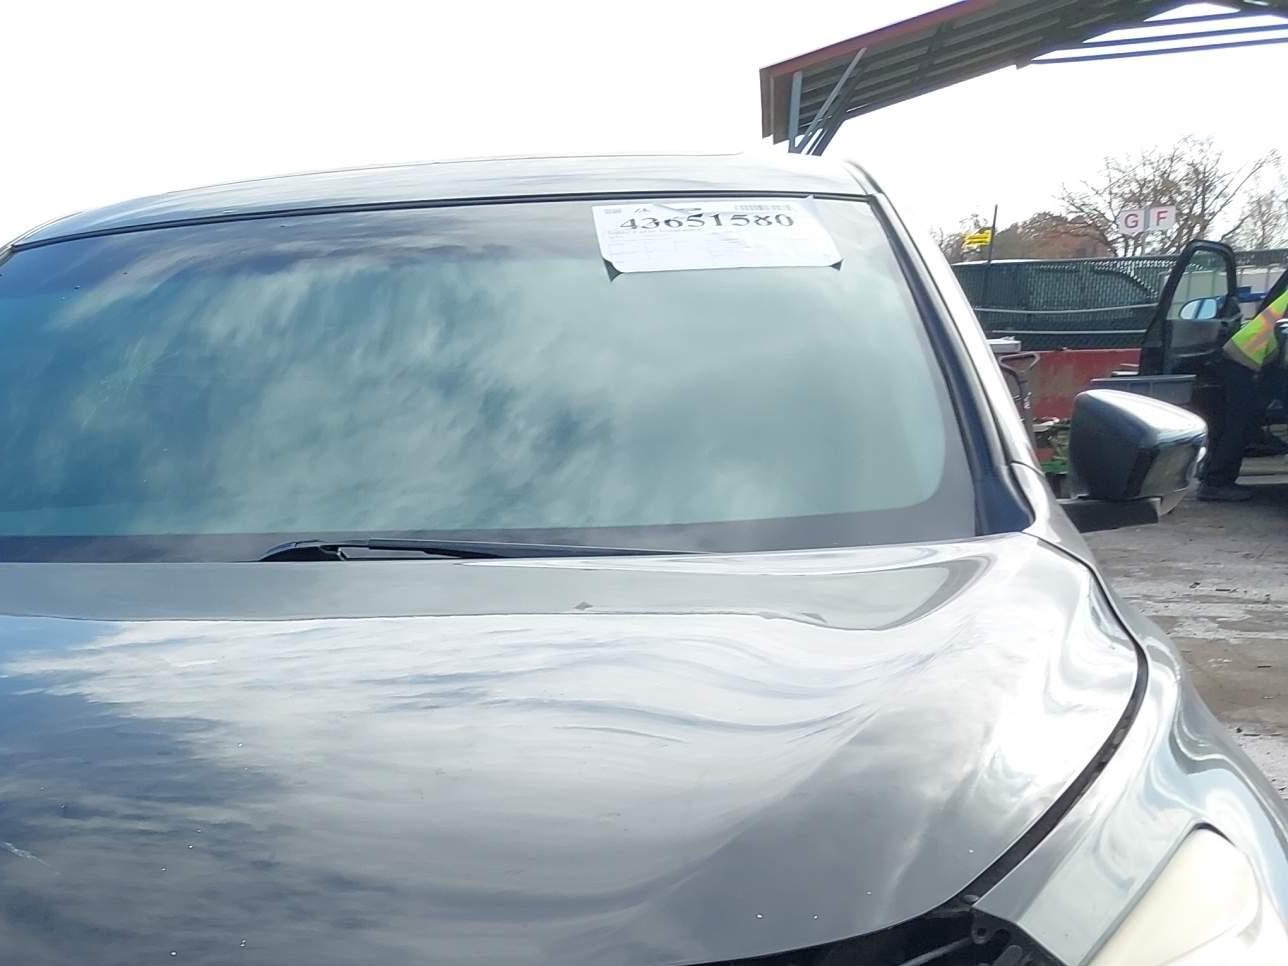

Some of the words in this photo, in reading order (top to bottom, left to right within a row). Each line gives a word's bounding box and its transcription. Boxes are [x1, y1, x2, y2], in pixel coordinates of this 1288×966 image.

[619, 213, 794, 230] 43651580
[1124, 213, 1139, 229] G
[1156, 210, 1168, 226] F
